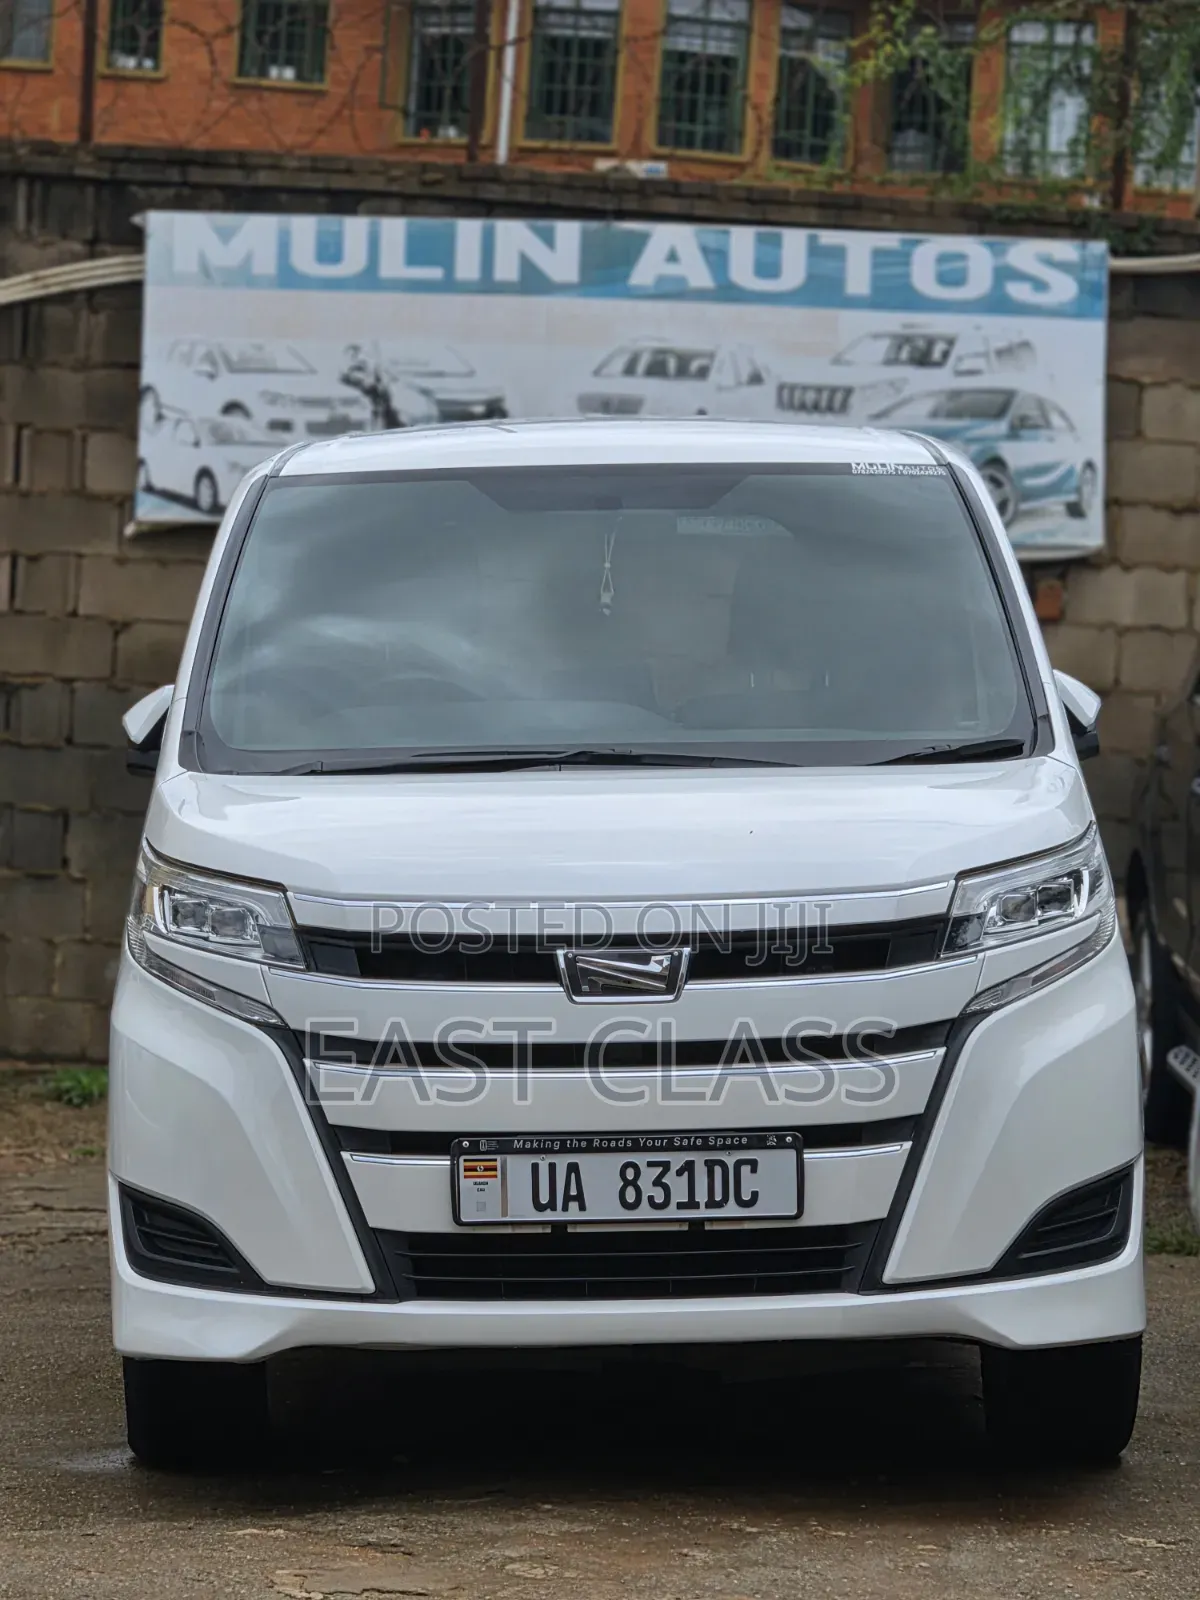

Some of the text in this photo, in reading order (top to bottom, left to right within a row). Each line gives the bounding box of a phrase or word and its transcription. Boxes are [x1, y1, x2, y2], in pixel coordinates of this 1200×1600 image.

[172, 214, 1081, 306] MULIN AUTOS
[513, 1136, 748, 1150] Making the Roads Your Safe Space
[531, 1158, 760, 1212] UA 831DC
